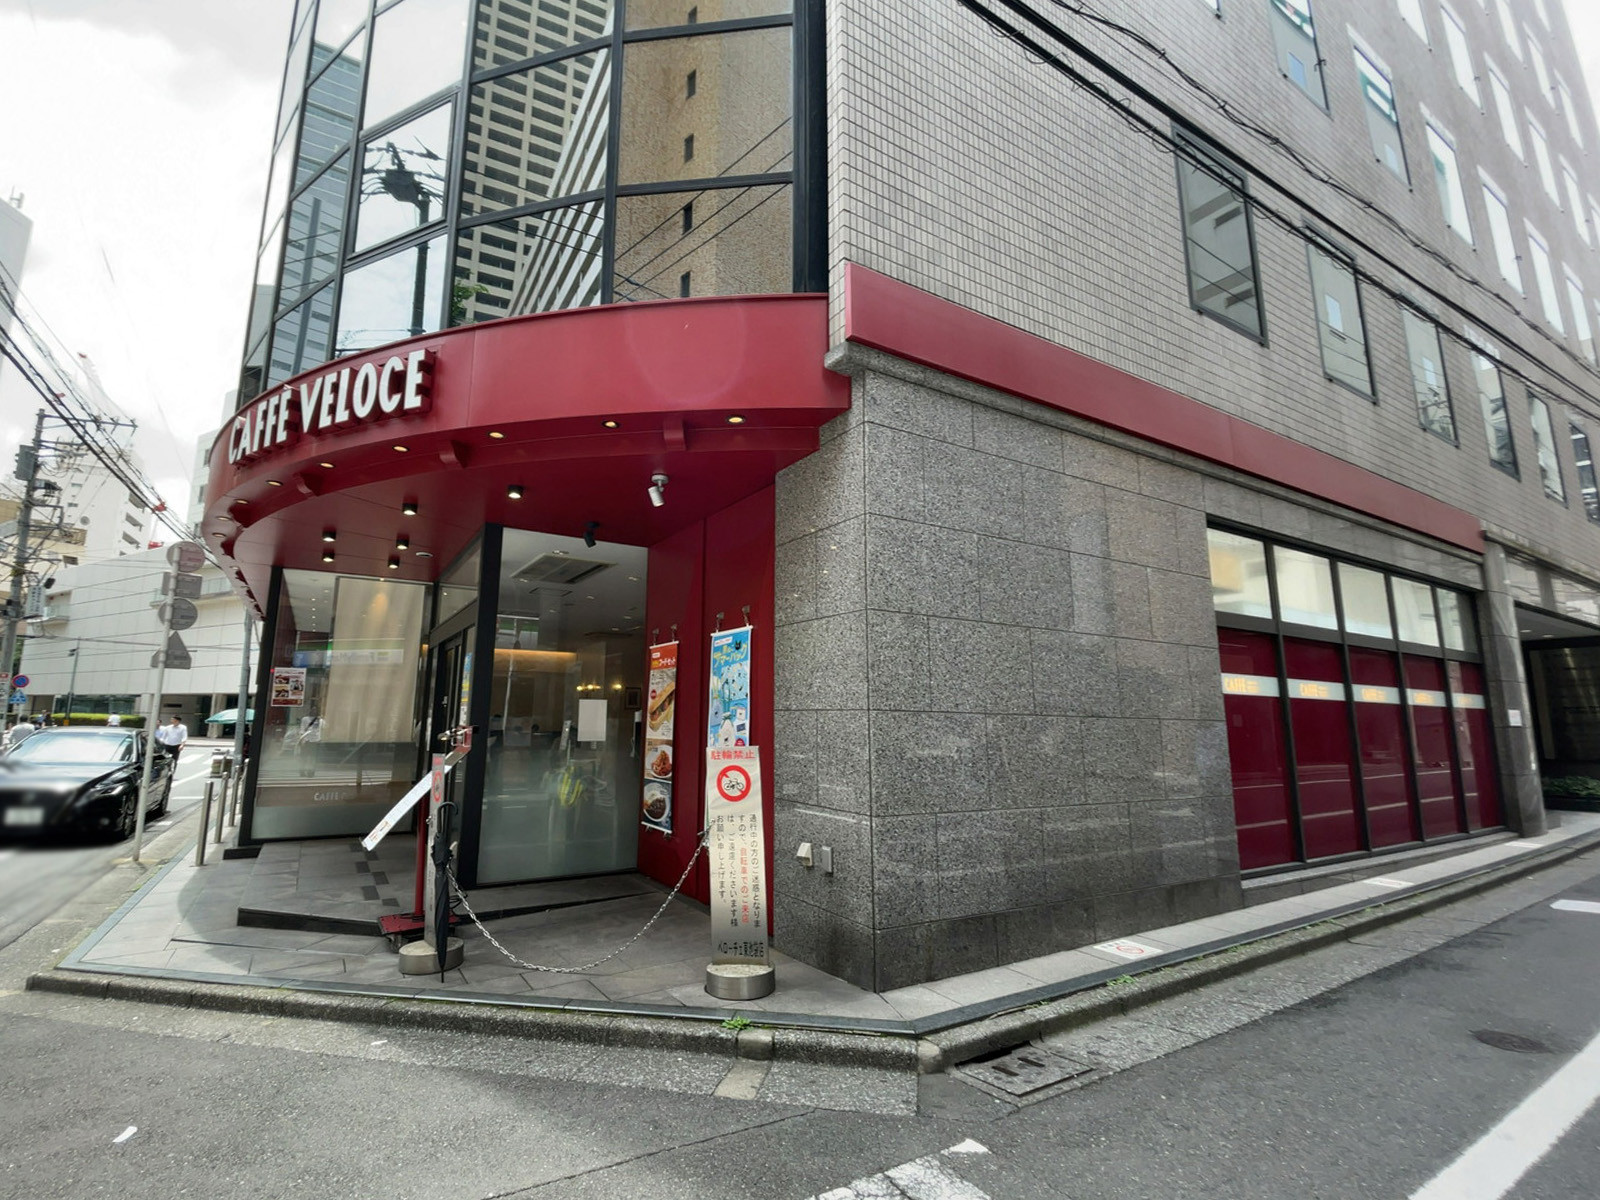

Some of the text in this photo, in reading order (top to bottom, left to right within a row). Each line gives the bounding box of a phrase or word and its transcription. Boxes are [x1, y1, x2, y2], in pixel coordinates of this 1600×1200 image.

[300, 349, 425, 434] VELOCE
[711, 750, 756, 760] 駐輪禁止
